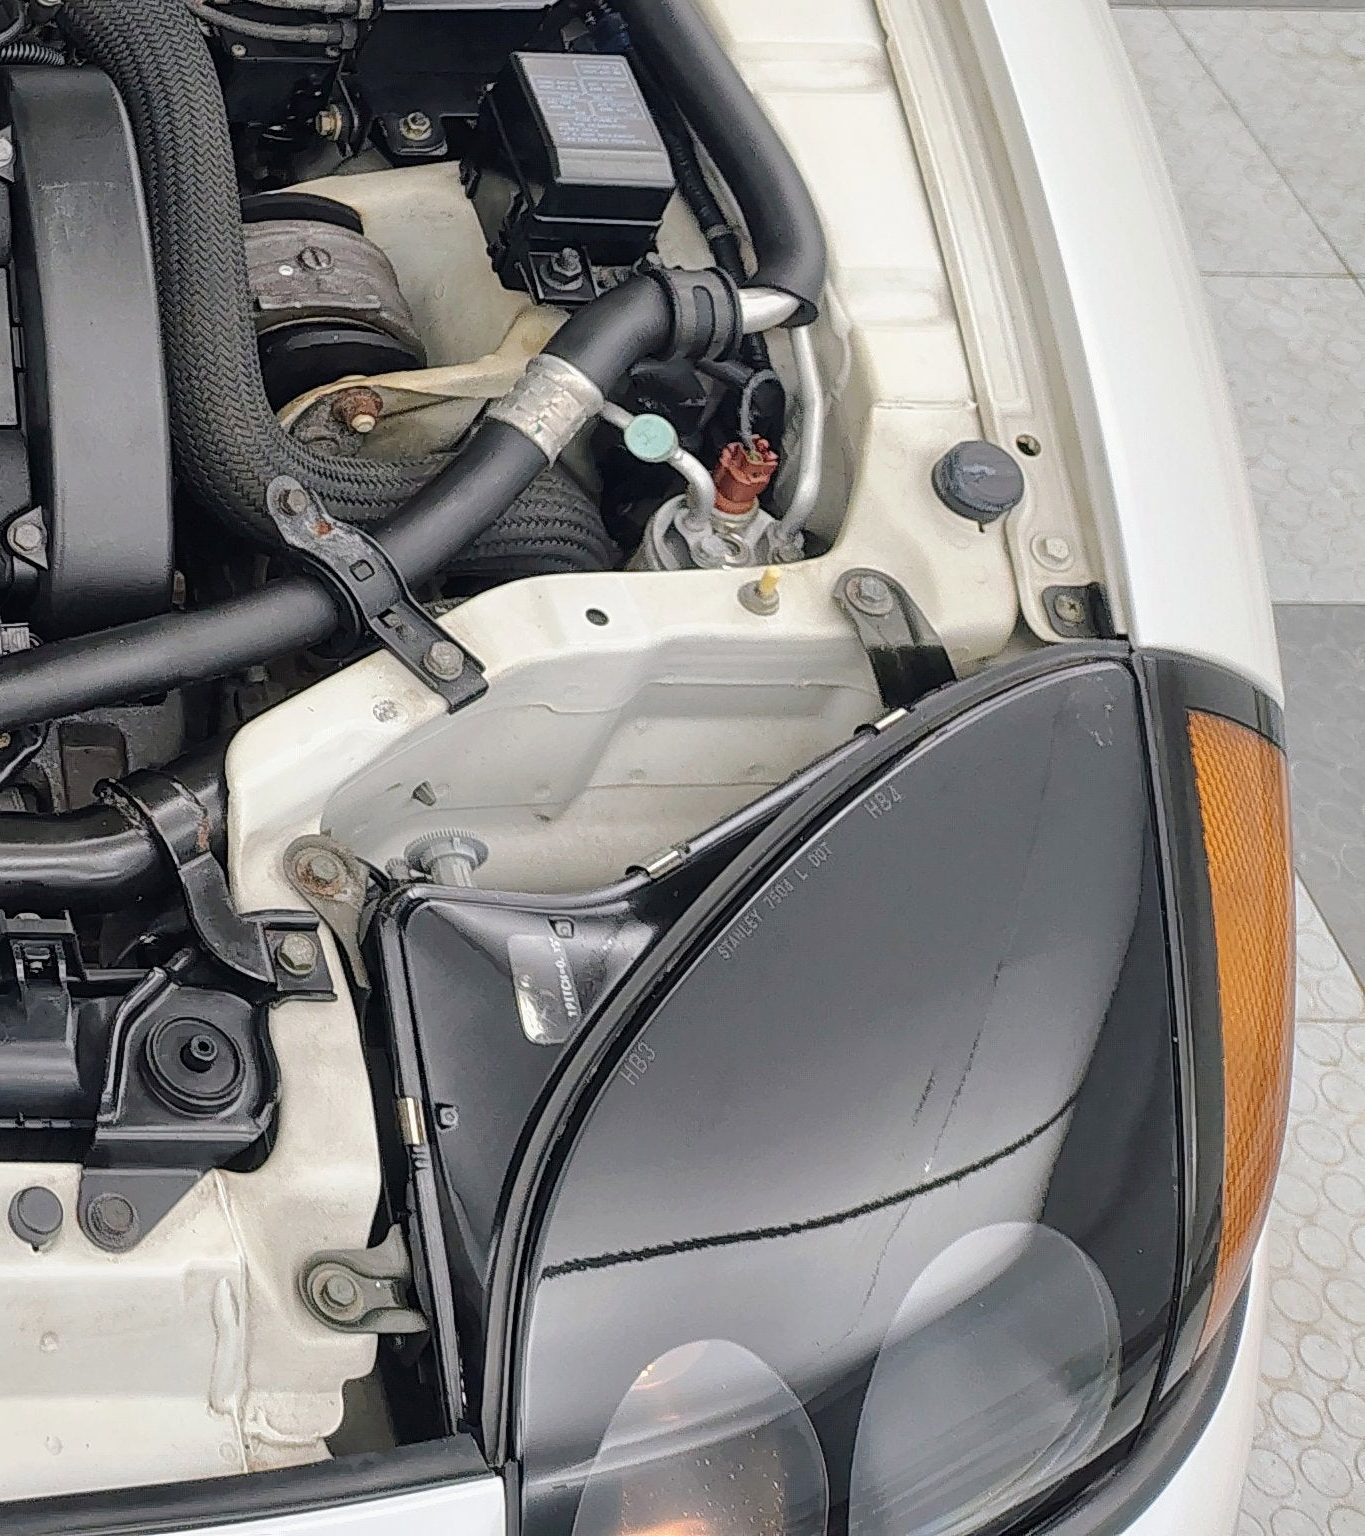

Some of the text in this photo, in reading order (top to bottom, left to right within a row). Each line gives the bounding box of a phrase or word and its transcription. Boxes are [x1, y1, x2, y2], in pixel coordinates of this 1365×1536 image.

[862, 786, 906, 819] HB4
[717, 912, 761, 960] STANLEY
[810, 842, 833, 868] DOT
[619, 1042, 658, 1086] HB3
